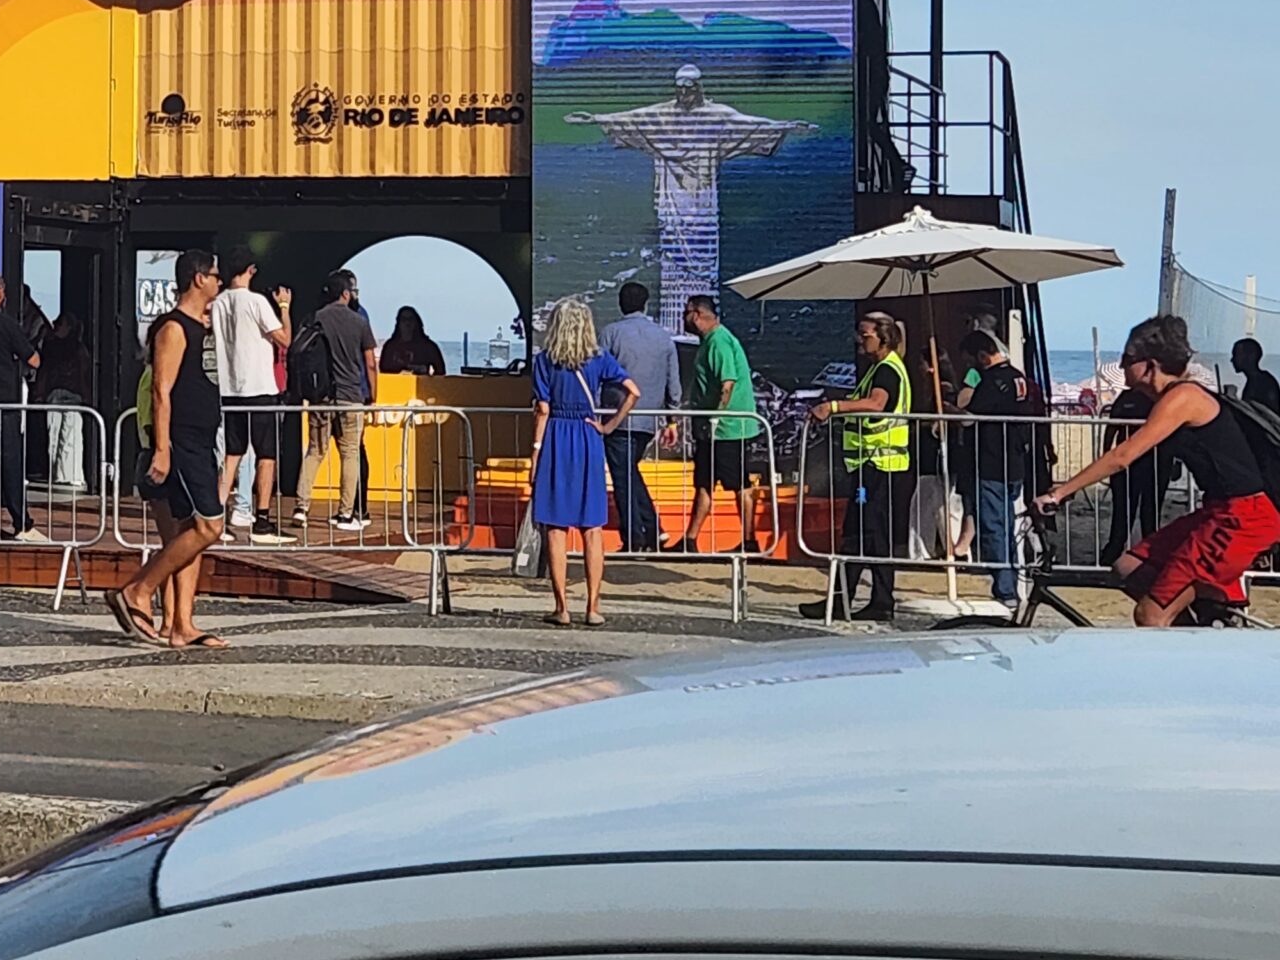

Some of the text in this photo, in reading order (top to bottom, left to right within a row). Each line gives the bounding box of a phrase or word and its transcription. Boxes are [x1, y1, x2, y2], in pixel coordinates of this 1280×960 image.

[343, 93, 525, 106] GOVERNO DO ESTADO
[344, 107, 525, 128] RIO DE JANEIRO
